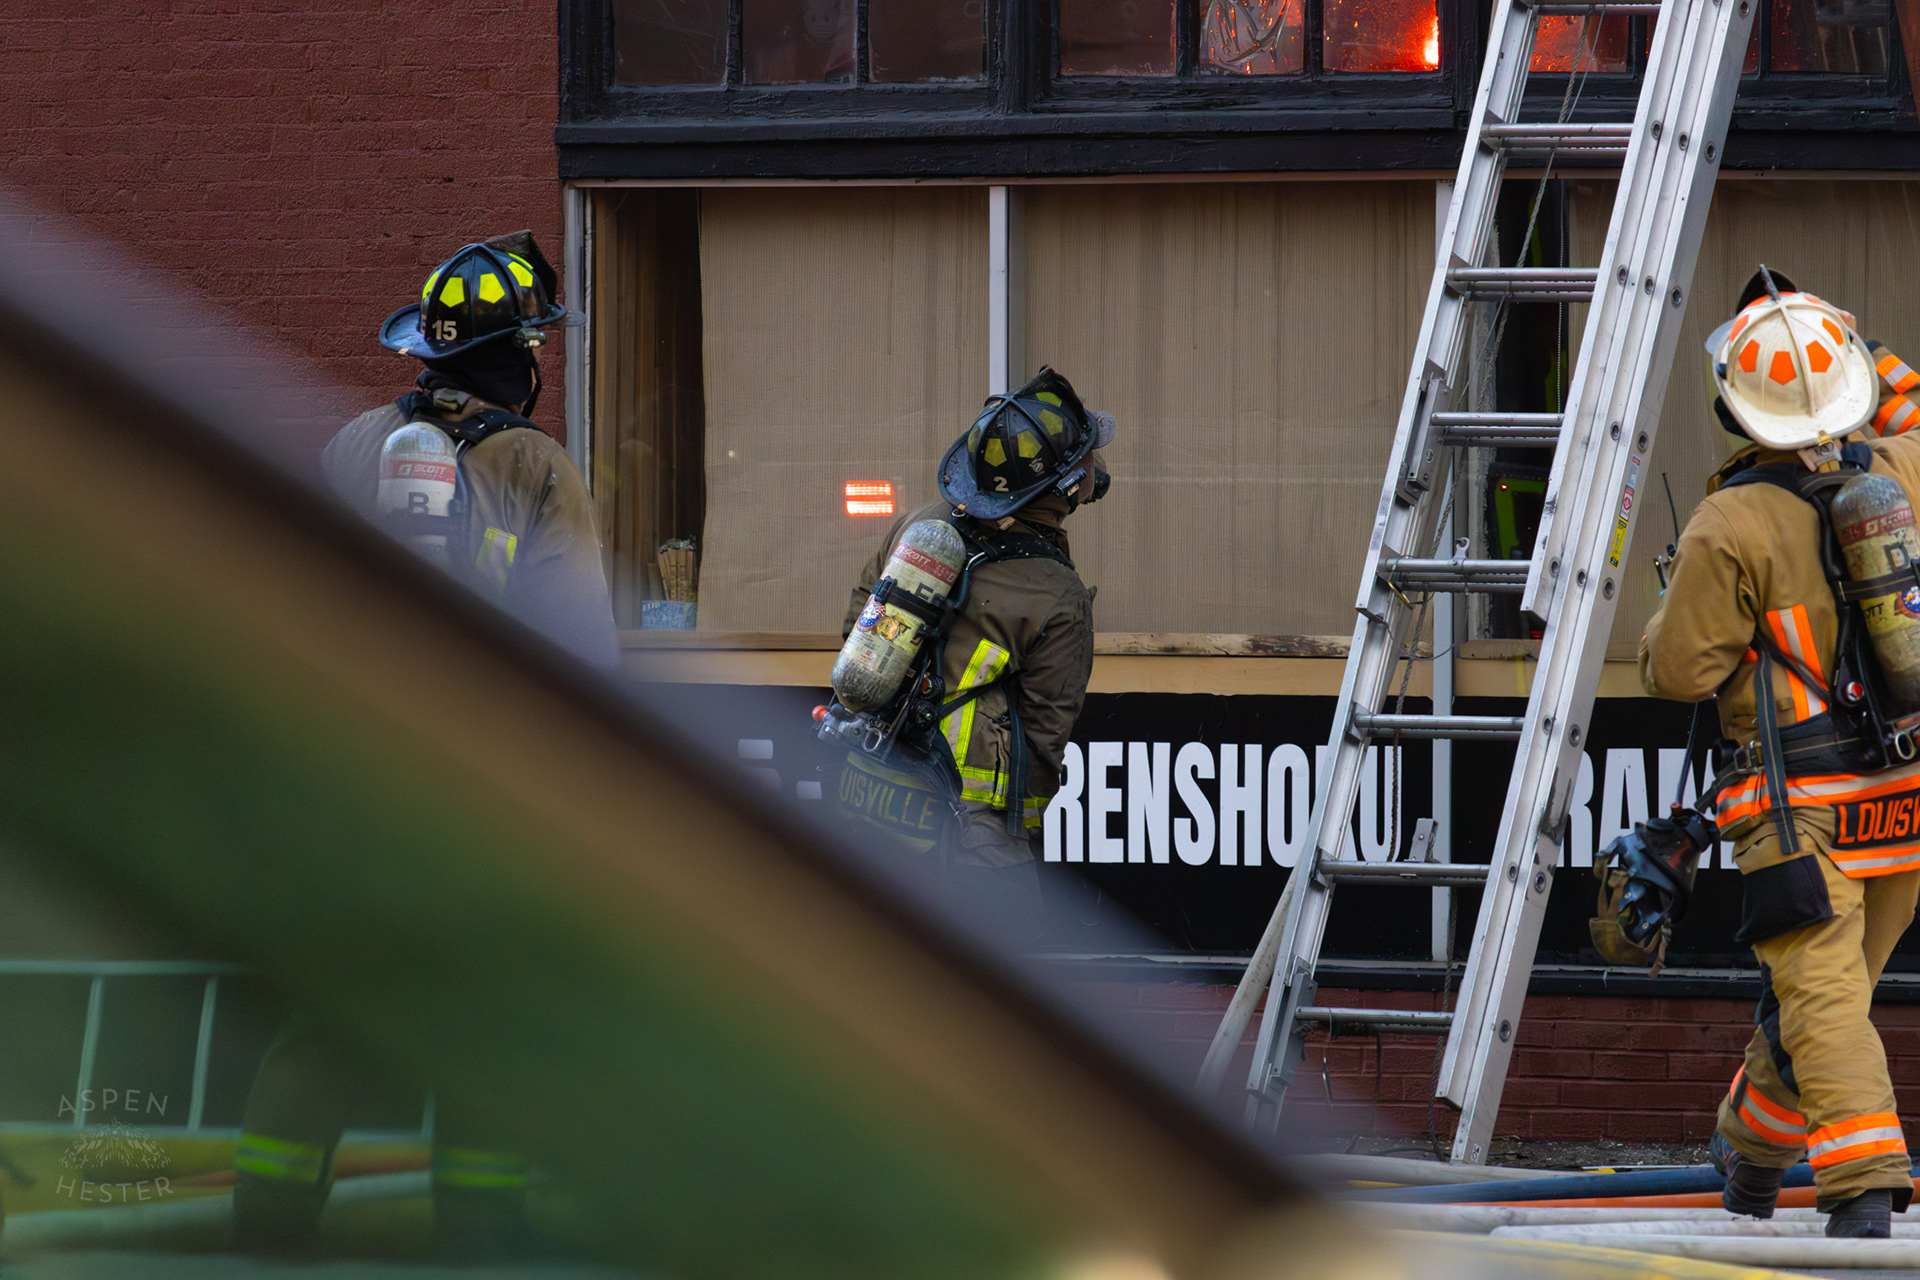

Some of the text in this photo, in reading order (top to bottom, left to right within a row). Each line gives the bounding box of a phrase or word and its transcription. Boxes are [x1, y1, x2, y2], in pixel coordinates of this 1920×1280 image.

[432, 320, 457, 341] 15
[413, 463, 446, 475] SCOTT
[993, 476, 1010, 493] 2
[903, 548, 931, 565] SCOTT
